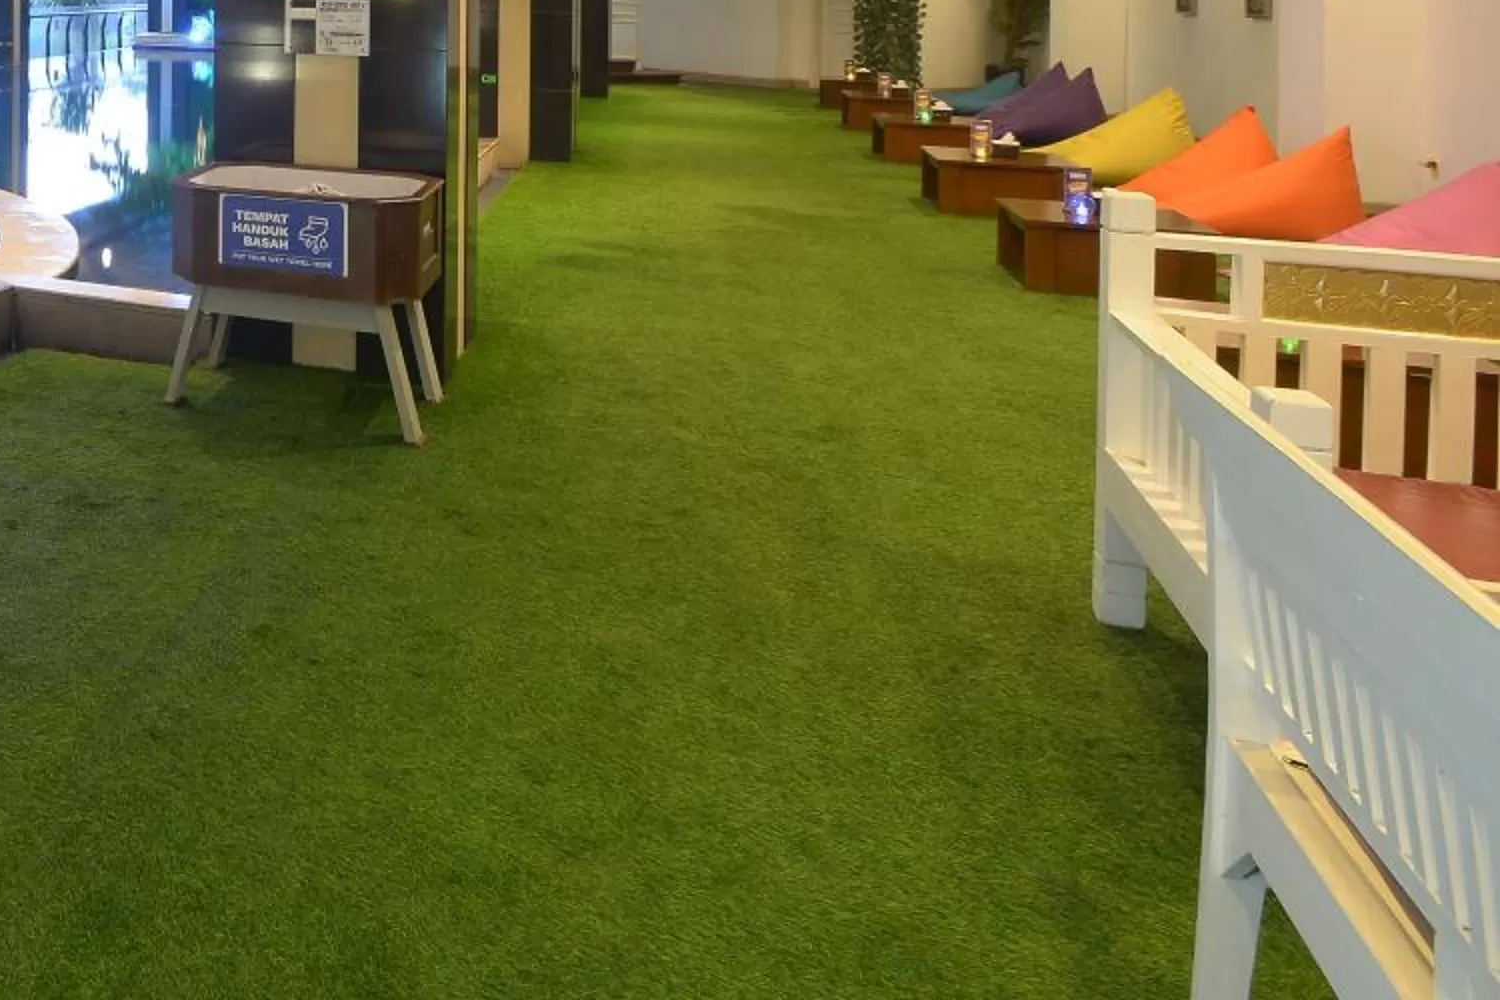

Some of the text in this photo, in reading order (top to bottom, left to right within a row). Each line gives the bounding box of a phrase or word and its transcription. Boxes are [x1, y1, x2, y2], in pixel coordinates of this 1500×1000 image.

[234, 209, 290, 224] TEMPAT
[232, 222, 289, 237] HANDUK
[243, 235, 289, 250] BASAH
